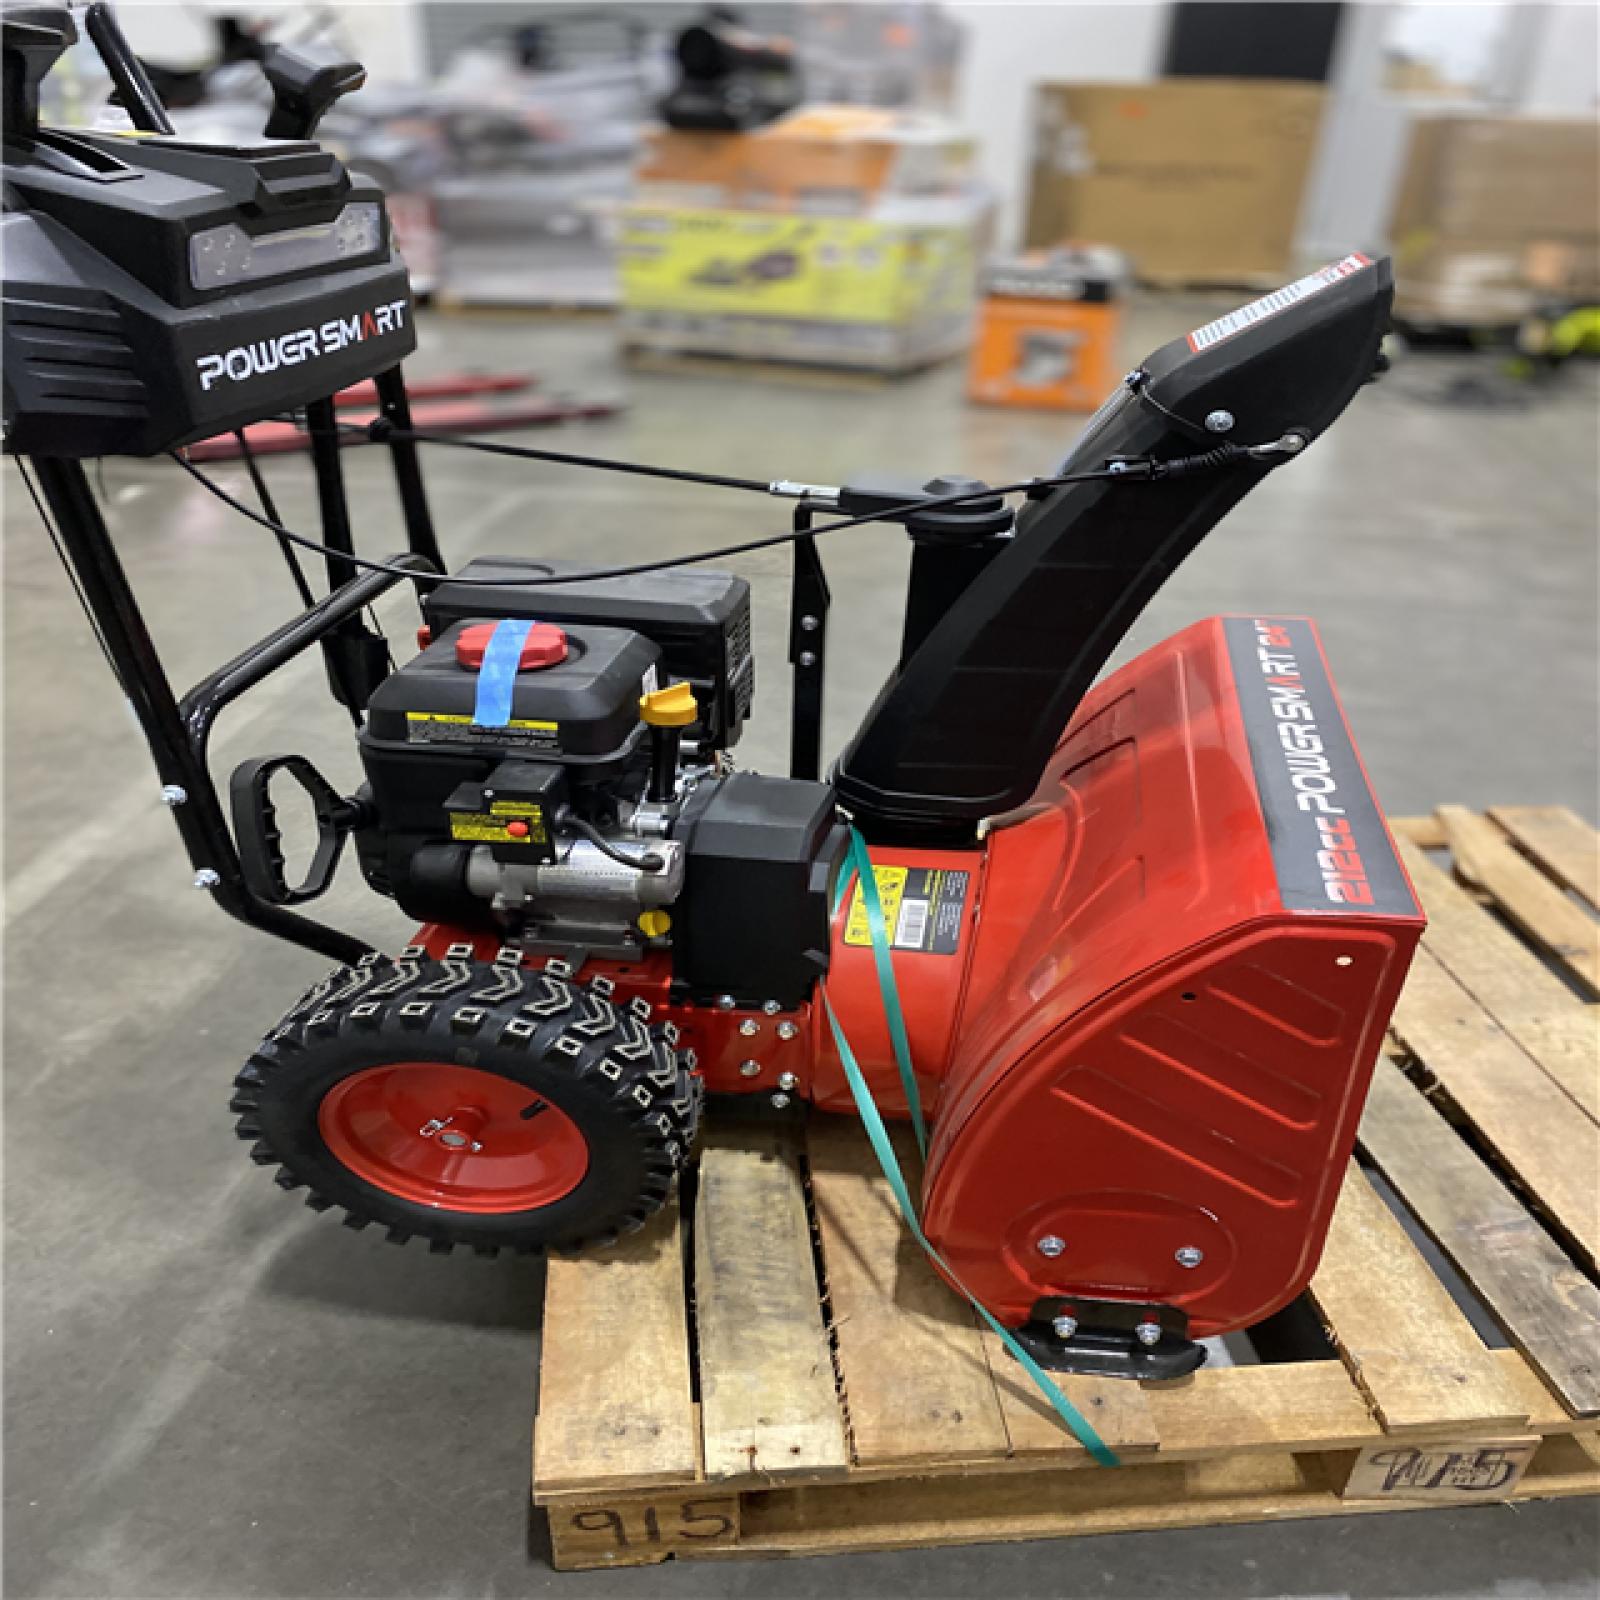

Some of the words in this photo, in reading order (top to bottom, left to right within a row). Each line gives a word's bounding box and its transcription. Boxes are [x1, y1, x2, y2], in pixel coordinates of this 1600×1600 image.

[1315, 816, 1376, 905] 212cc
[1369, 1447, 1528, 1490] 915
[571, 1497, 734, 1546] 915
